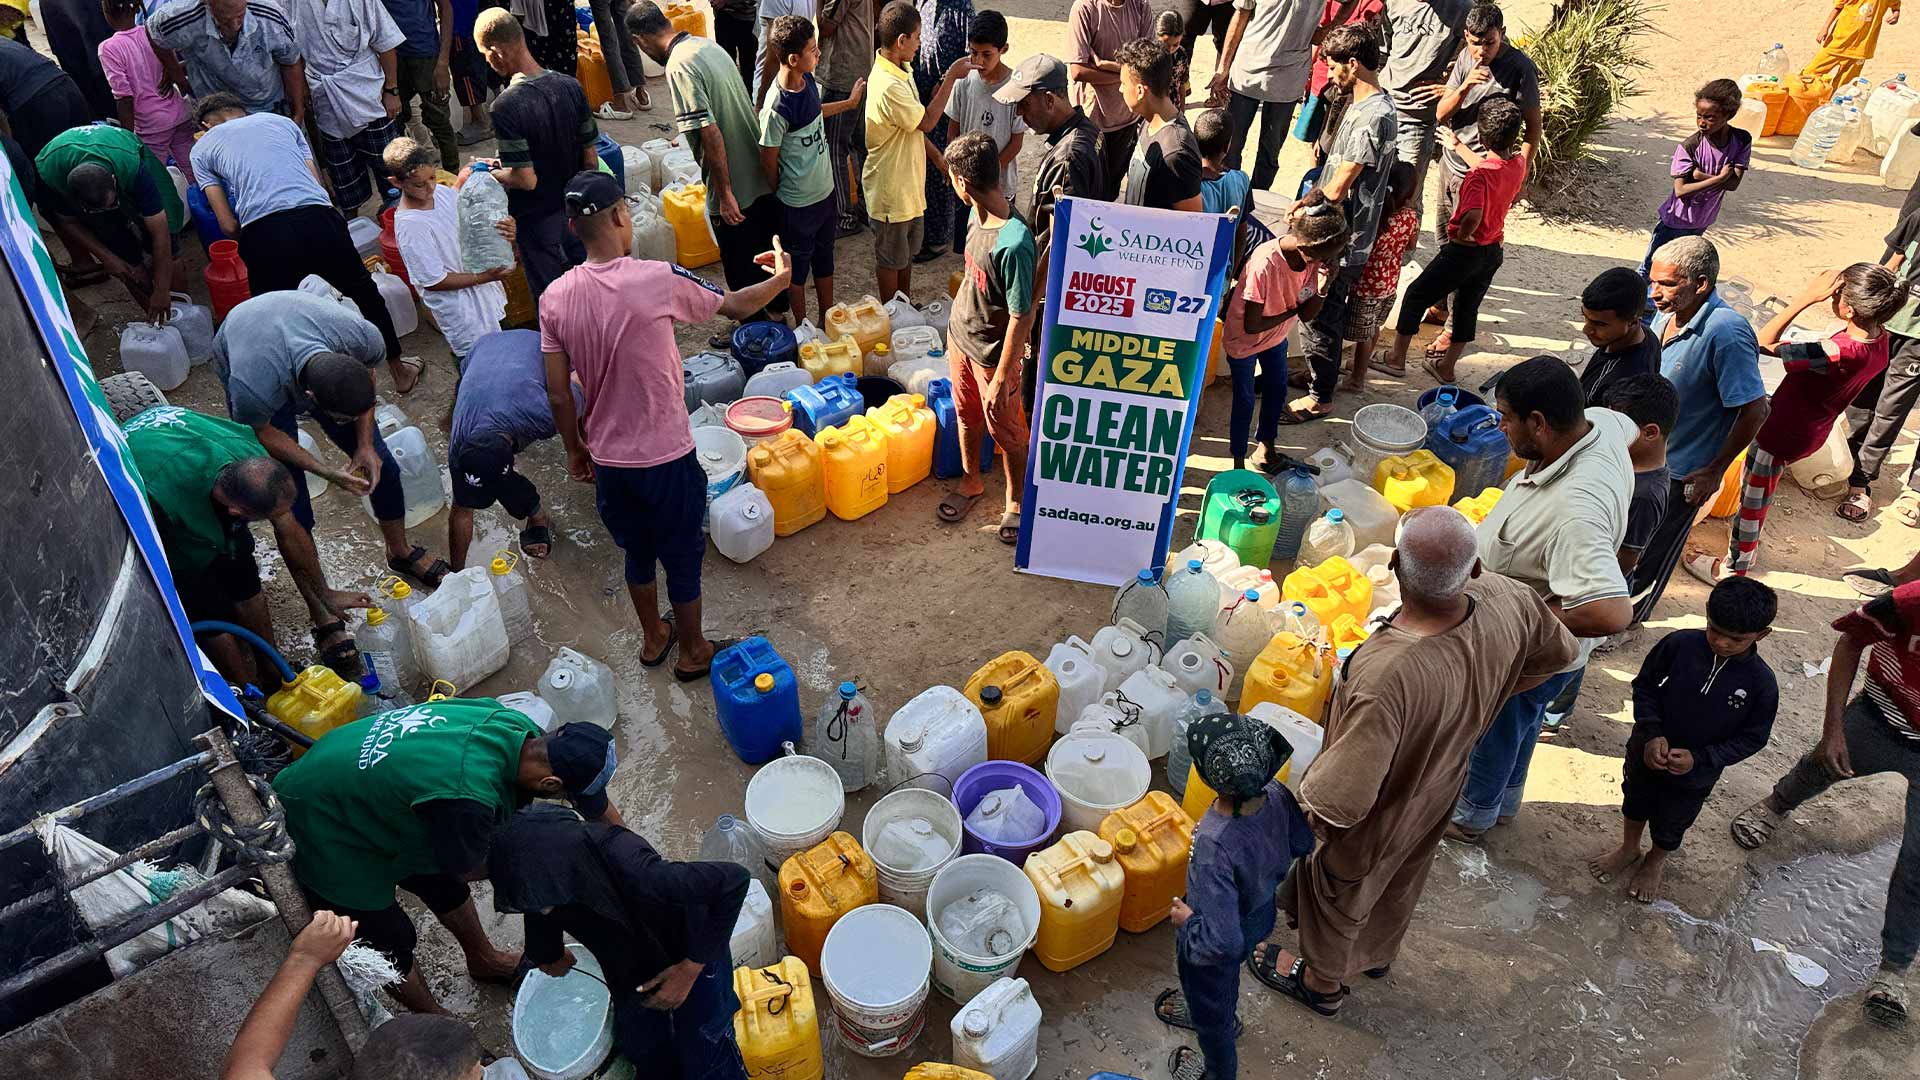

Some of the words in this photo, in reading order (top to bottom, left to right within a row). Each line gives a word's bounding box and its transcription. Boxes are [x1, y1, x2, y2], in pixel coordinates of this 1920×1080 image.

[1119, 229, 1204, 260] SADAQA
[1119, 252, 1168, 265] WELFARE
[1170, 257, 1204, 271] FUND
[1069, 271, 1136, 297] AUGUST
[1073, 294, 1125, 315] 2025
[1177, 296, 1205, 314] 27
[1071, 330, 1176, 361] MIDDLE
[1051, 350, 1184, 398] GAZA
[1042, 394, 1184, 456] CLEAN
[1040, 441, 1173, 496] WATER
[1038, 506, 1155, 531] sadaqa.org.au
[359, 735, 375, 770] FUND
